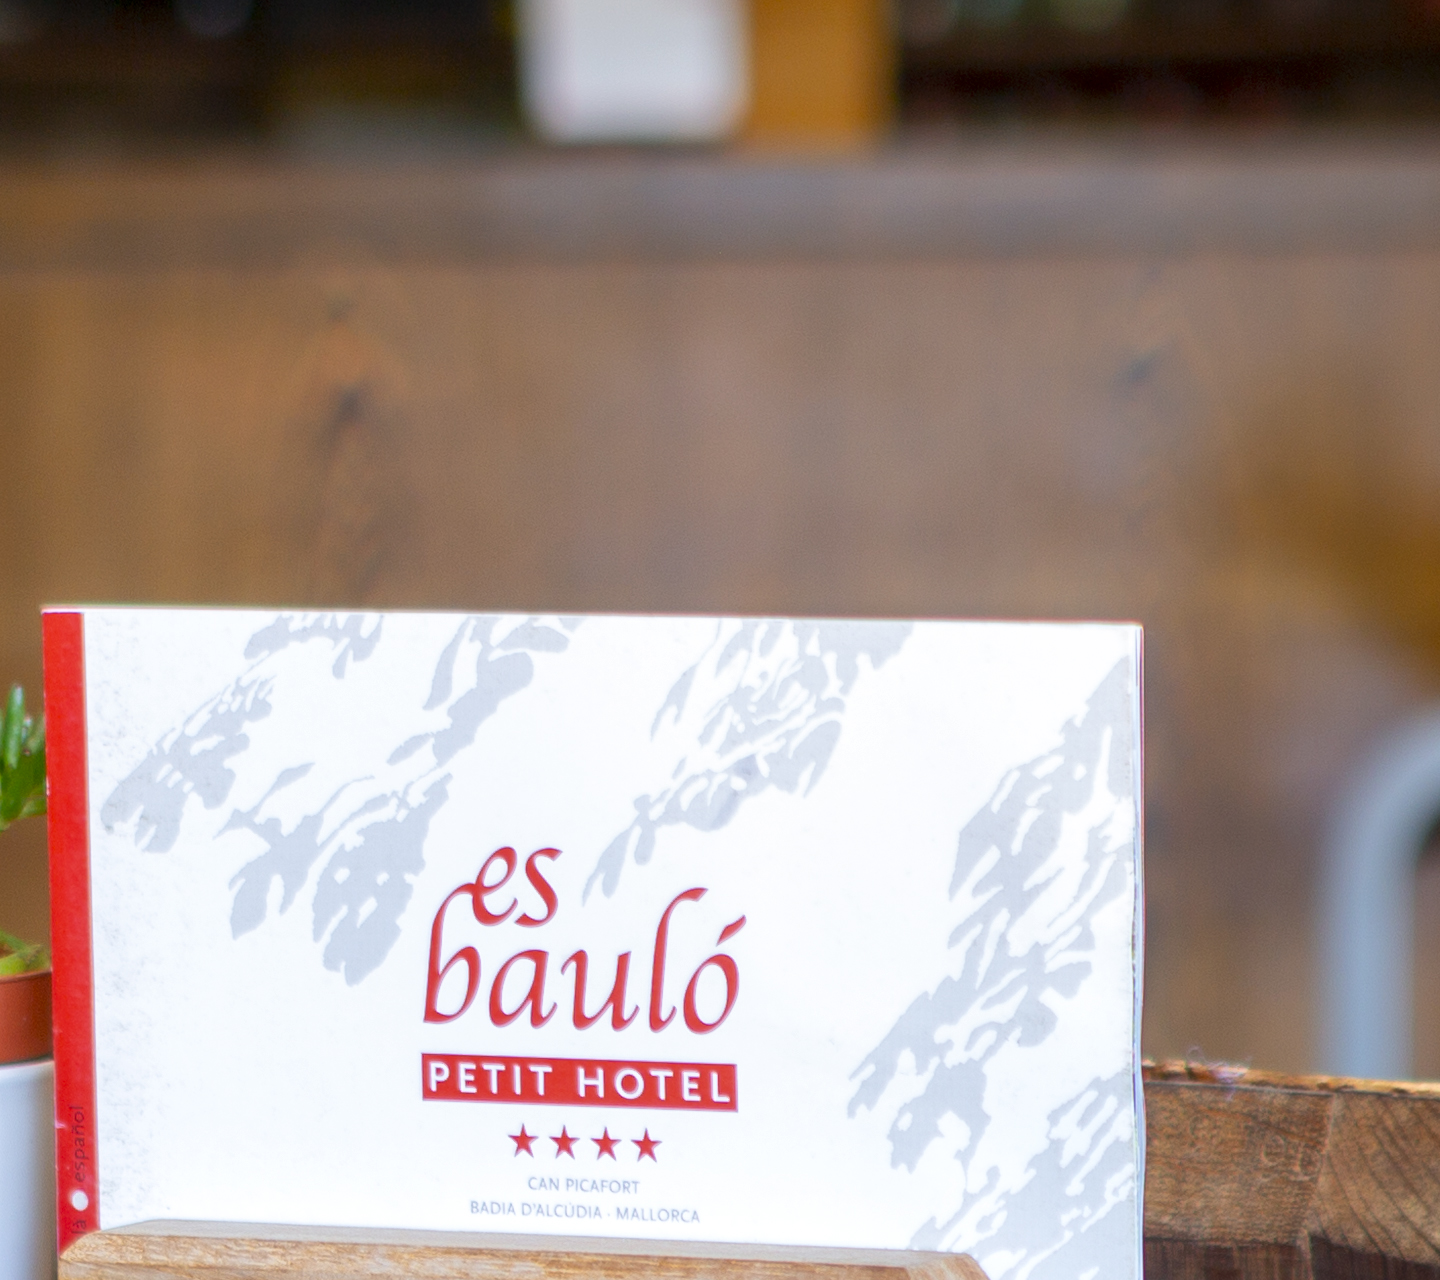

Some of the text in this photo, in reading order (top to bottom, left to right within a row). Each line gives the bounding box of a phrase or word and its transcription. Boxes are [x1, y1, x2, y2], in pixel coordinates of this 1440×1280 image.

[472, 846, 562, 928] es
[423, 883, 747, 1035] bauló
[429, 1061, 731, 1103] PETIT HOTEL
[69, 1105, 89, 1183] español
[470, 1200, 516, 1215] BADIA
[616, 1207, 700, 1224] MALLORCA
[528, 1176, 640, 1194] CAN PICAFORT
